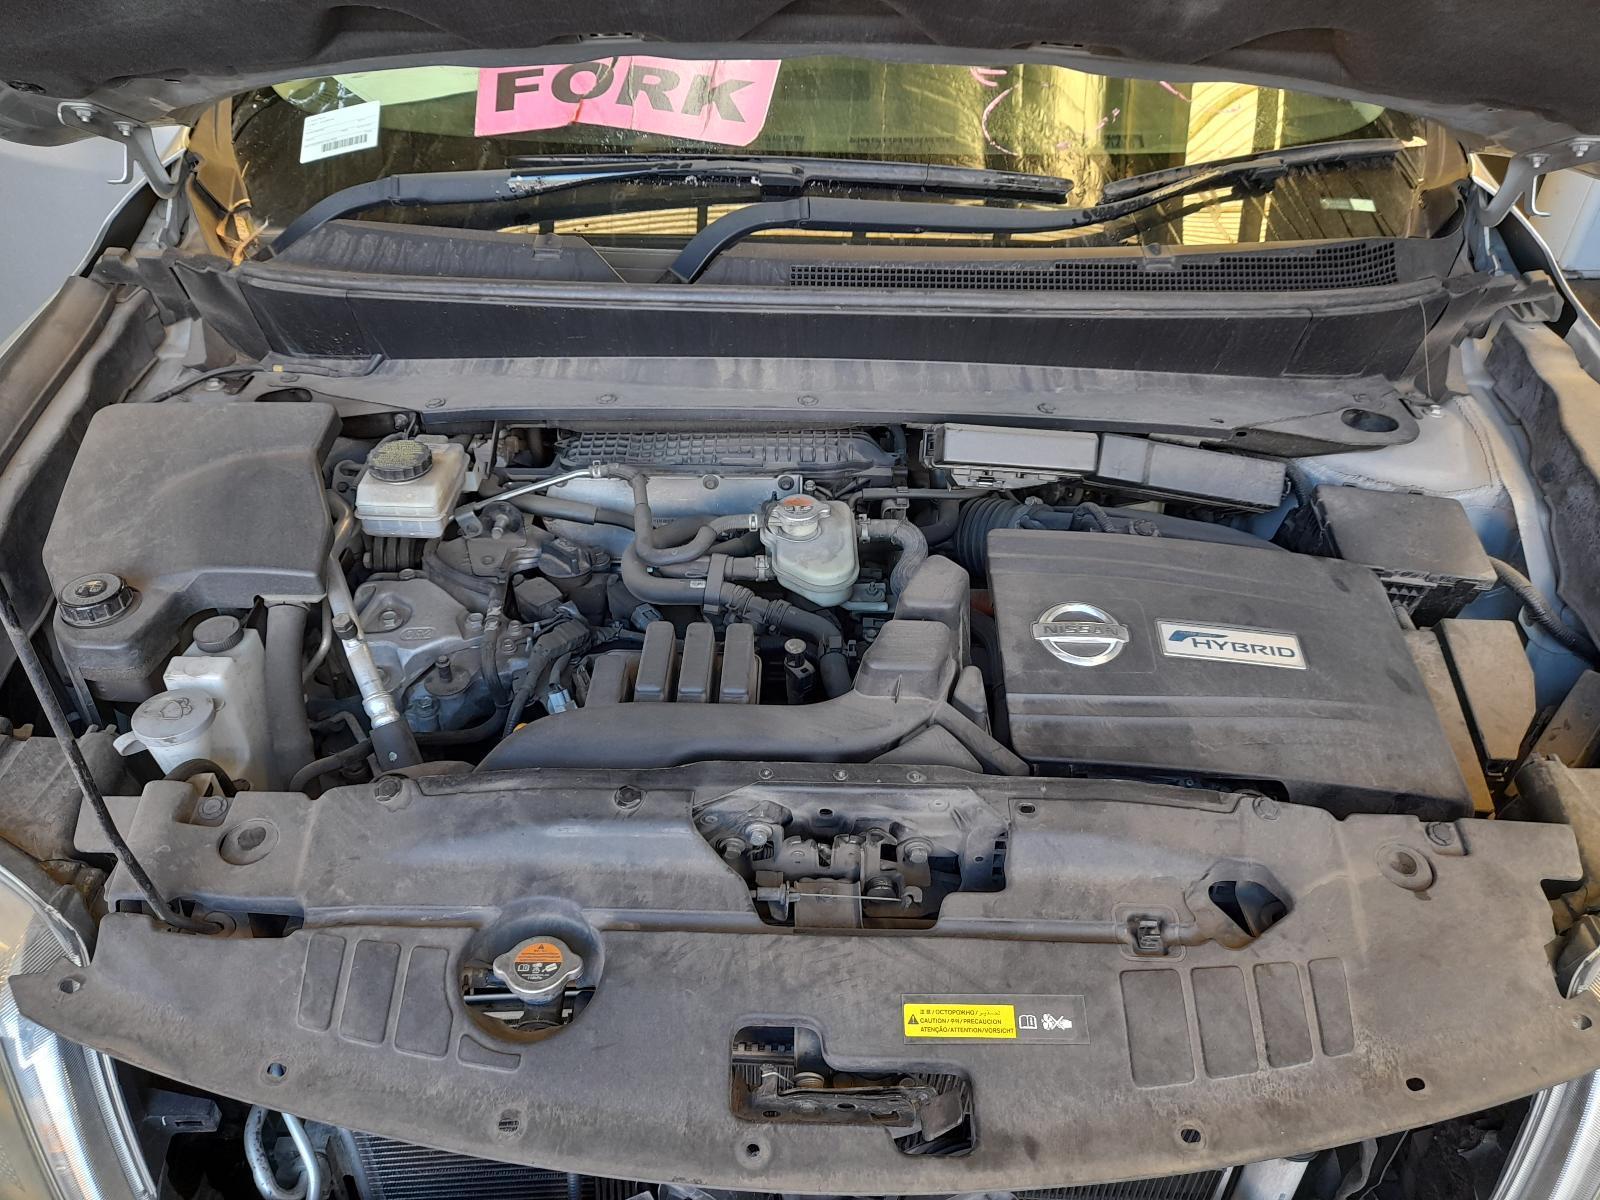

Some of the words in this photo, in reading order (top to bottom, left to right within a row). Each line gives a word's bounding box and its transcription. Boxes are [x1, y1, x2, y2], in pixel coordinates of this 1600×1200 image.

[495, 61, 755, 123] FORK
[1043, 625, 1119, 636] NISSAN
[1191, 638, 1296, 658] HYBRID
